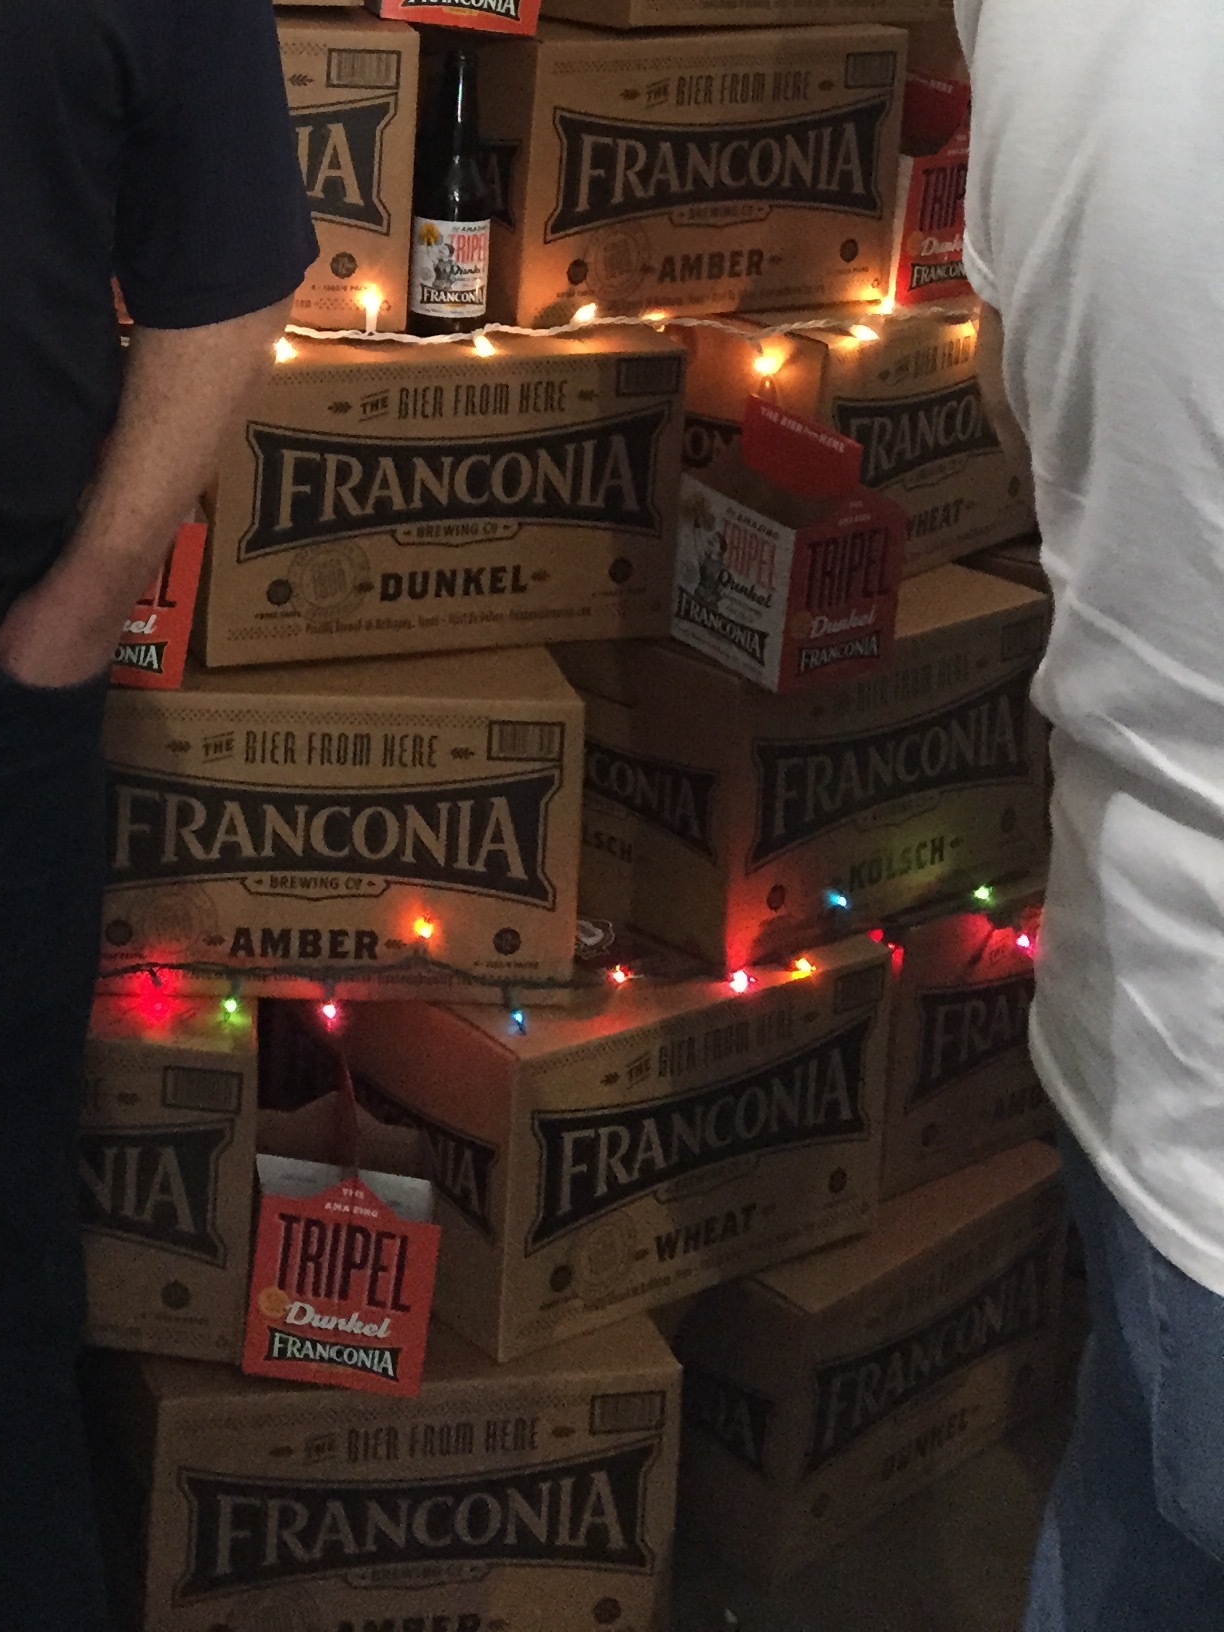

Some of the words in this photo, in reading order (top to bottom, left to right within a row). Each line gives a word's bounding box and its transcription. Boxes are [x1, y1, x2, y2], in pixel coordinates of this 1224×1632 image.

[718, 71, 767, 105] FROM
[574, 122, 867, 214] FRANCONIA
[656, 246, 766, 285] AMBER
[359, 394, 390, 416] THE
[397, 384, 444, 421] BIER
[451, 380, 511, 418] FROM
[517, 379, 569, 415] HERE
[274, 432, 641, 532] FRANCONIA
[415, 520, 480, 539] BREWING
[378, 564, 530, 604] DUNKEL
[676, 586, 765, 659] FRANCONIA
[201, 736, 235, 759] THE
[243, 730, 298, 767] BIER
[306, 730, 372, 767] FROM
[381, 732, 440, 769] HERE
[774, 691, 1021, 817] FRANCONIA
[111, 782, 531, 883] FRANCONIA
[267, 874, 342, 892] BREWING
[228, 926, 380, 962] AMBER
[556, 1043, 855, 1219] FRANCONIA
[653, 1201, 758, 1266] WHEAT
[276, 1212, 412, 1314] TRIPEL
[284, 1300, 392, 1340] Dunkel
[272, 1331, 395, 1378] FRANCONIA
[214, 1468, 628, 1577] FRANCONIA
